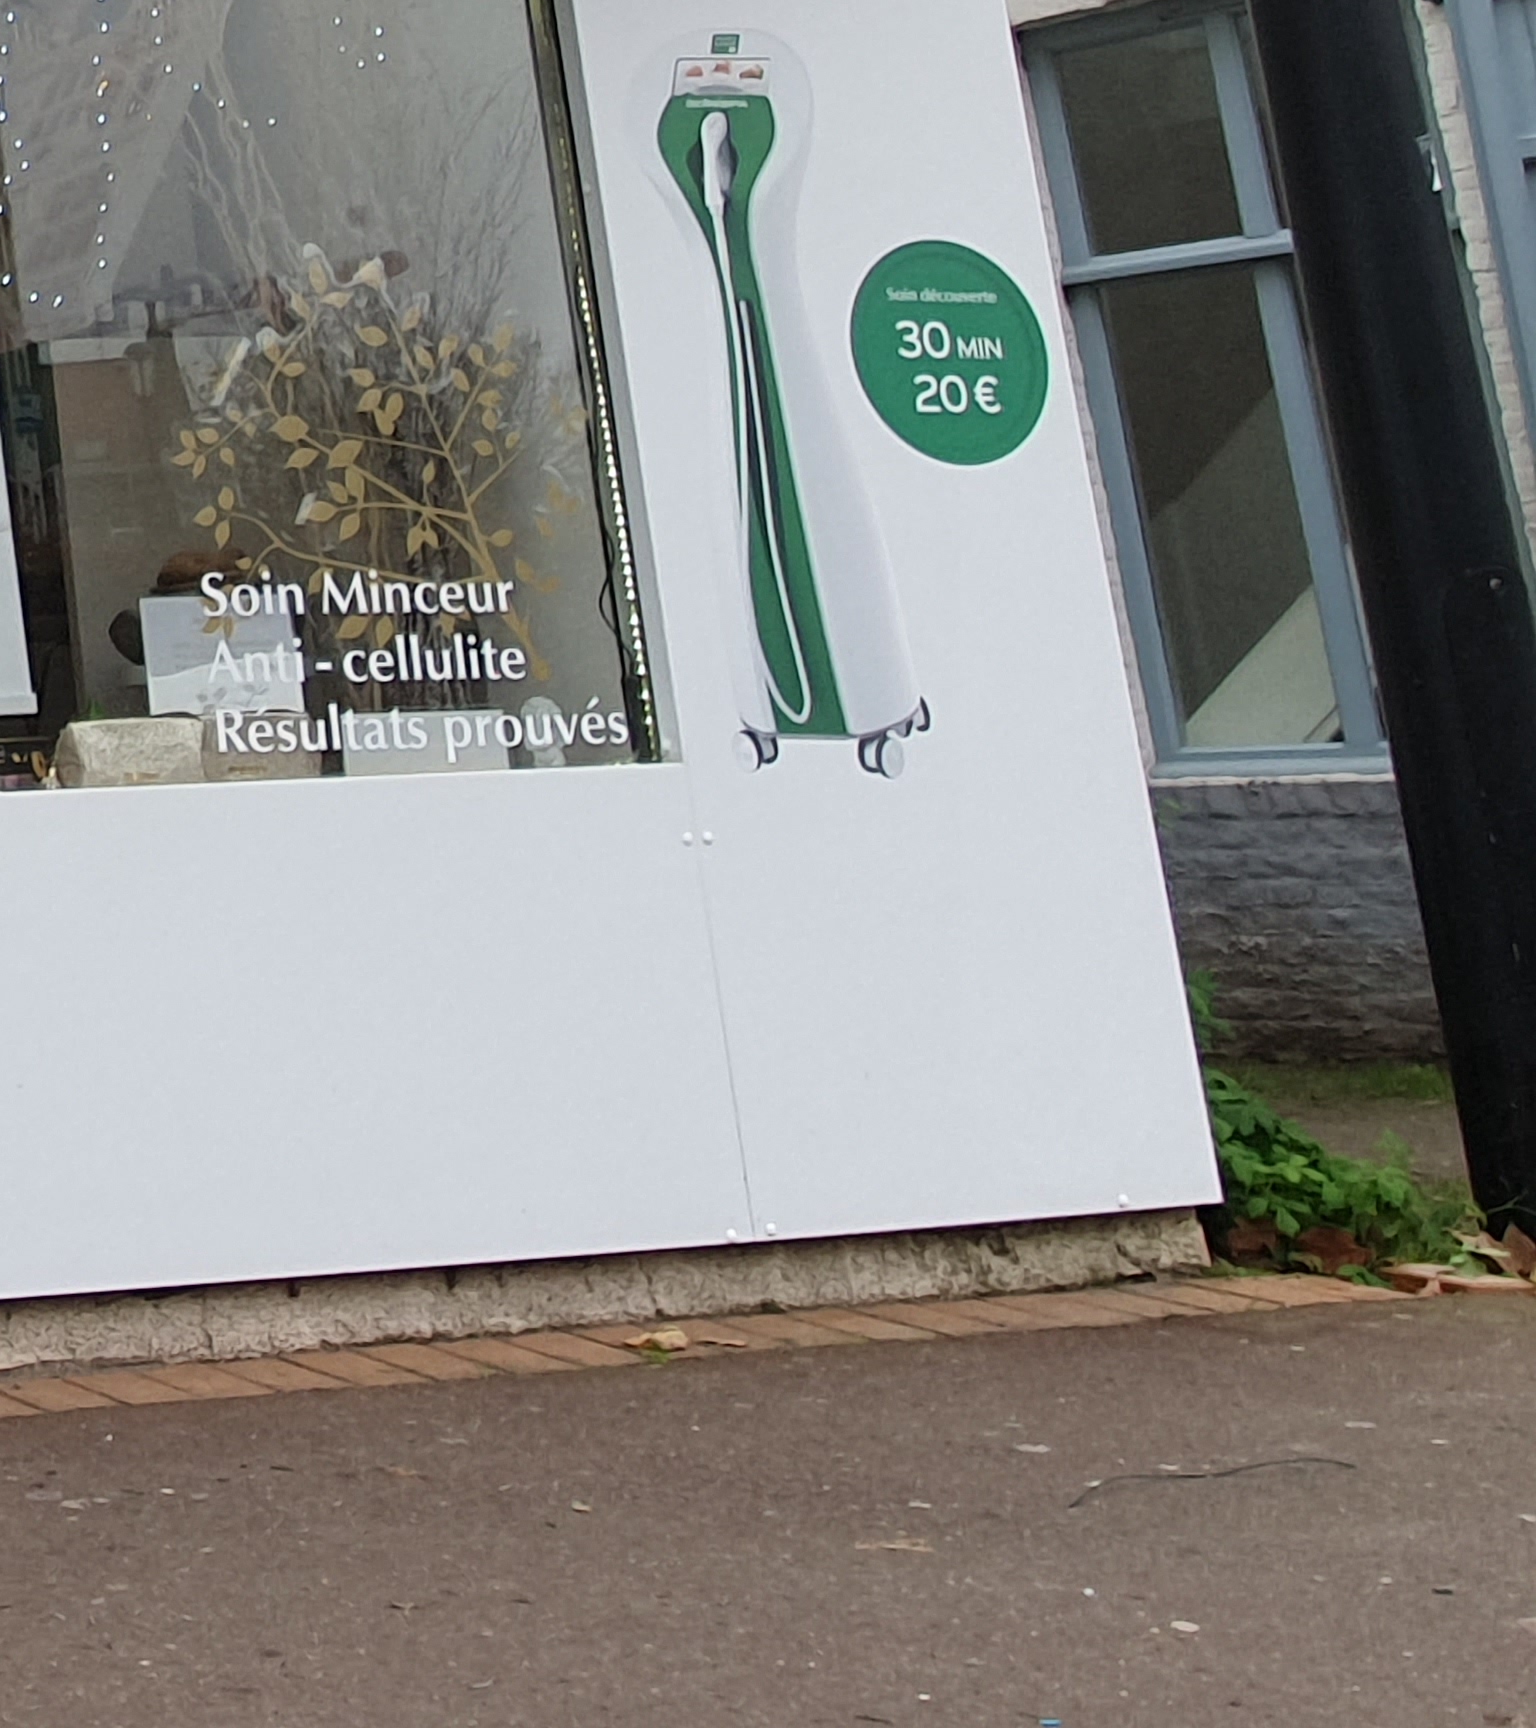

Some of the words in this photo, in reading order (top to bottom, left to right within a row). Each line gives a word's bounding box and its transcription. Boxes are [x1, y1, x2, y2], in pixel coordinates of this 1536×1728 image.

[886, 286, 918, 302] Soin
[894, 319, 951, 359] 30
[956, 336, 1004, 360] MIN
[199, 569, 306, 618] Soin
[320, 569, 515, 617] Minceur
[206, 636, 306, 685] Anti
[342, 632, 528, 683] cellulite
[215, 700, 429, 755] Résultats
[443, 695, 629, 764] prouvés
